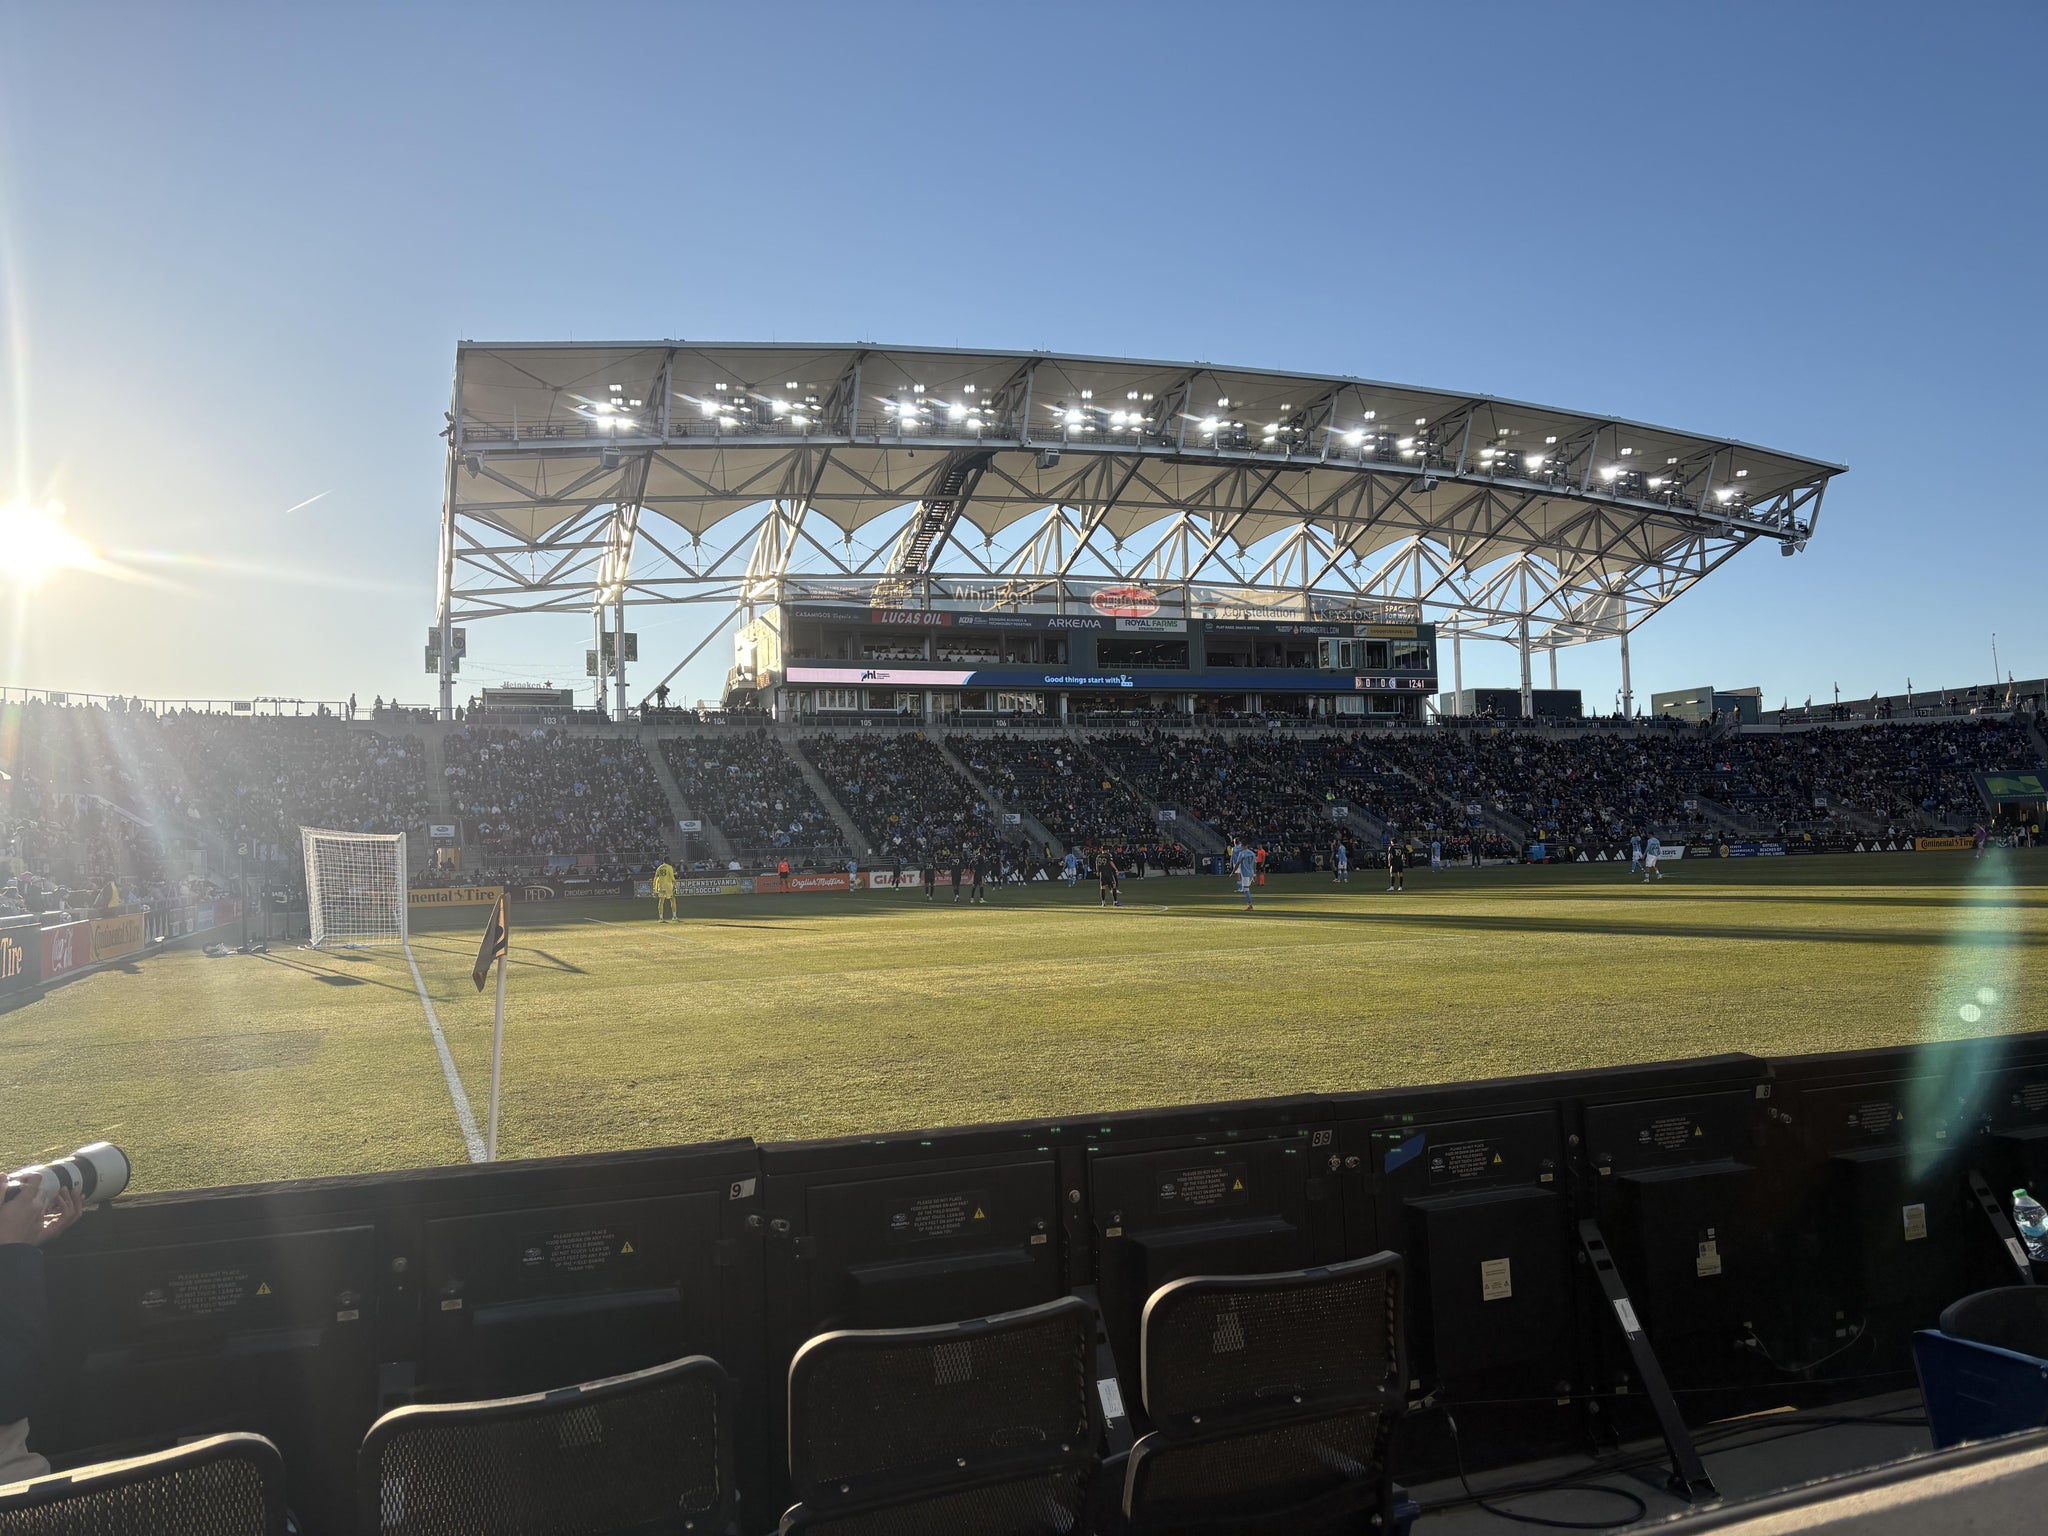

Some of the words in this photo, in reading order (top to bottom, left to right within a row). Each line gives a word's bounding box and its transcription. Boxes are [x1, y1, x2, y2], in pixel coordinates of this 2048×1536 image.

[950, 585, 1034, 611] Whirlpool
[1224, 605, 1296, 618] Constellation
[881, 611, 921, 624] LUCAS
[923, 613, 942, 625] OIL
[1048, 618, 1101, 628] ARKEMA
[861, 670, 877, 682] phl
[1044, 675, 1063, 683] Good
[1065, 676, 1087, 685] things
[1088, 676, 1104, 684] start
[1105, 676, 1120, 684] with
[1365, 678, 1371, 688] 0
[1380, 678, 1386, 688] 0
[1409, 679, 1425, 689] 12:41
[543, 717, 556, 725] 103
[713, 717, 726, 725] 104
[996, 719, 1007, 727] 106
[1921, 839, 1955, 849] Continental
[687, 879, 737, 888] PENNSYLVANIA
[791, 878, 818, 889] English
[818, 877, 845, 886] Muffins
[407, 890, 452, 903] inental
[463, 889, 495, 901] Tire
[524, 888, 549, 900] PFD
[564, 888, 592, 899] protein
[593, 885, 621, 897] served
[96, 922, 125, 949] Continental
[0, 937, 22, 979] Tire
[732, 1184, 741, 1198] 9
